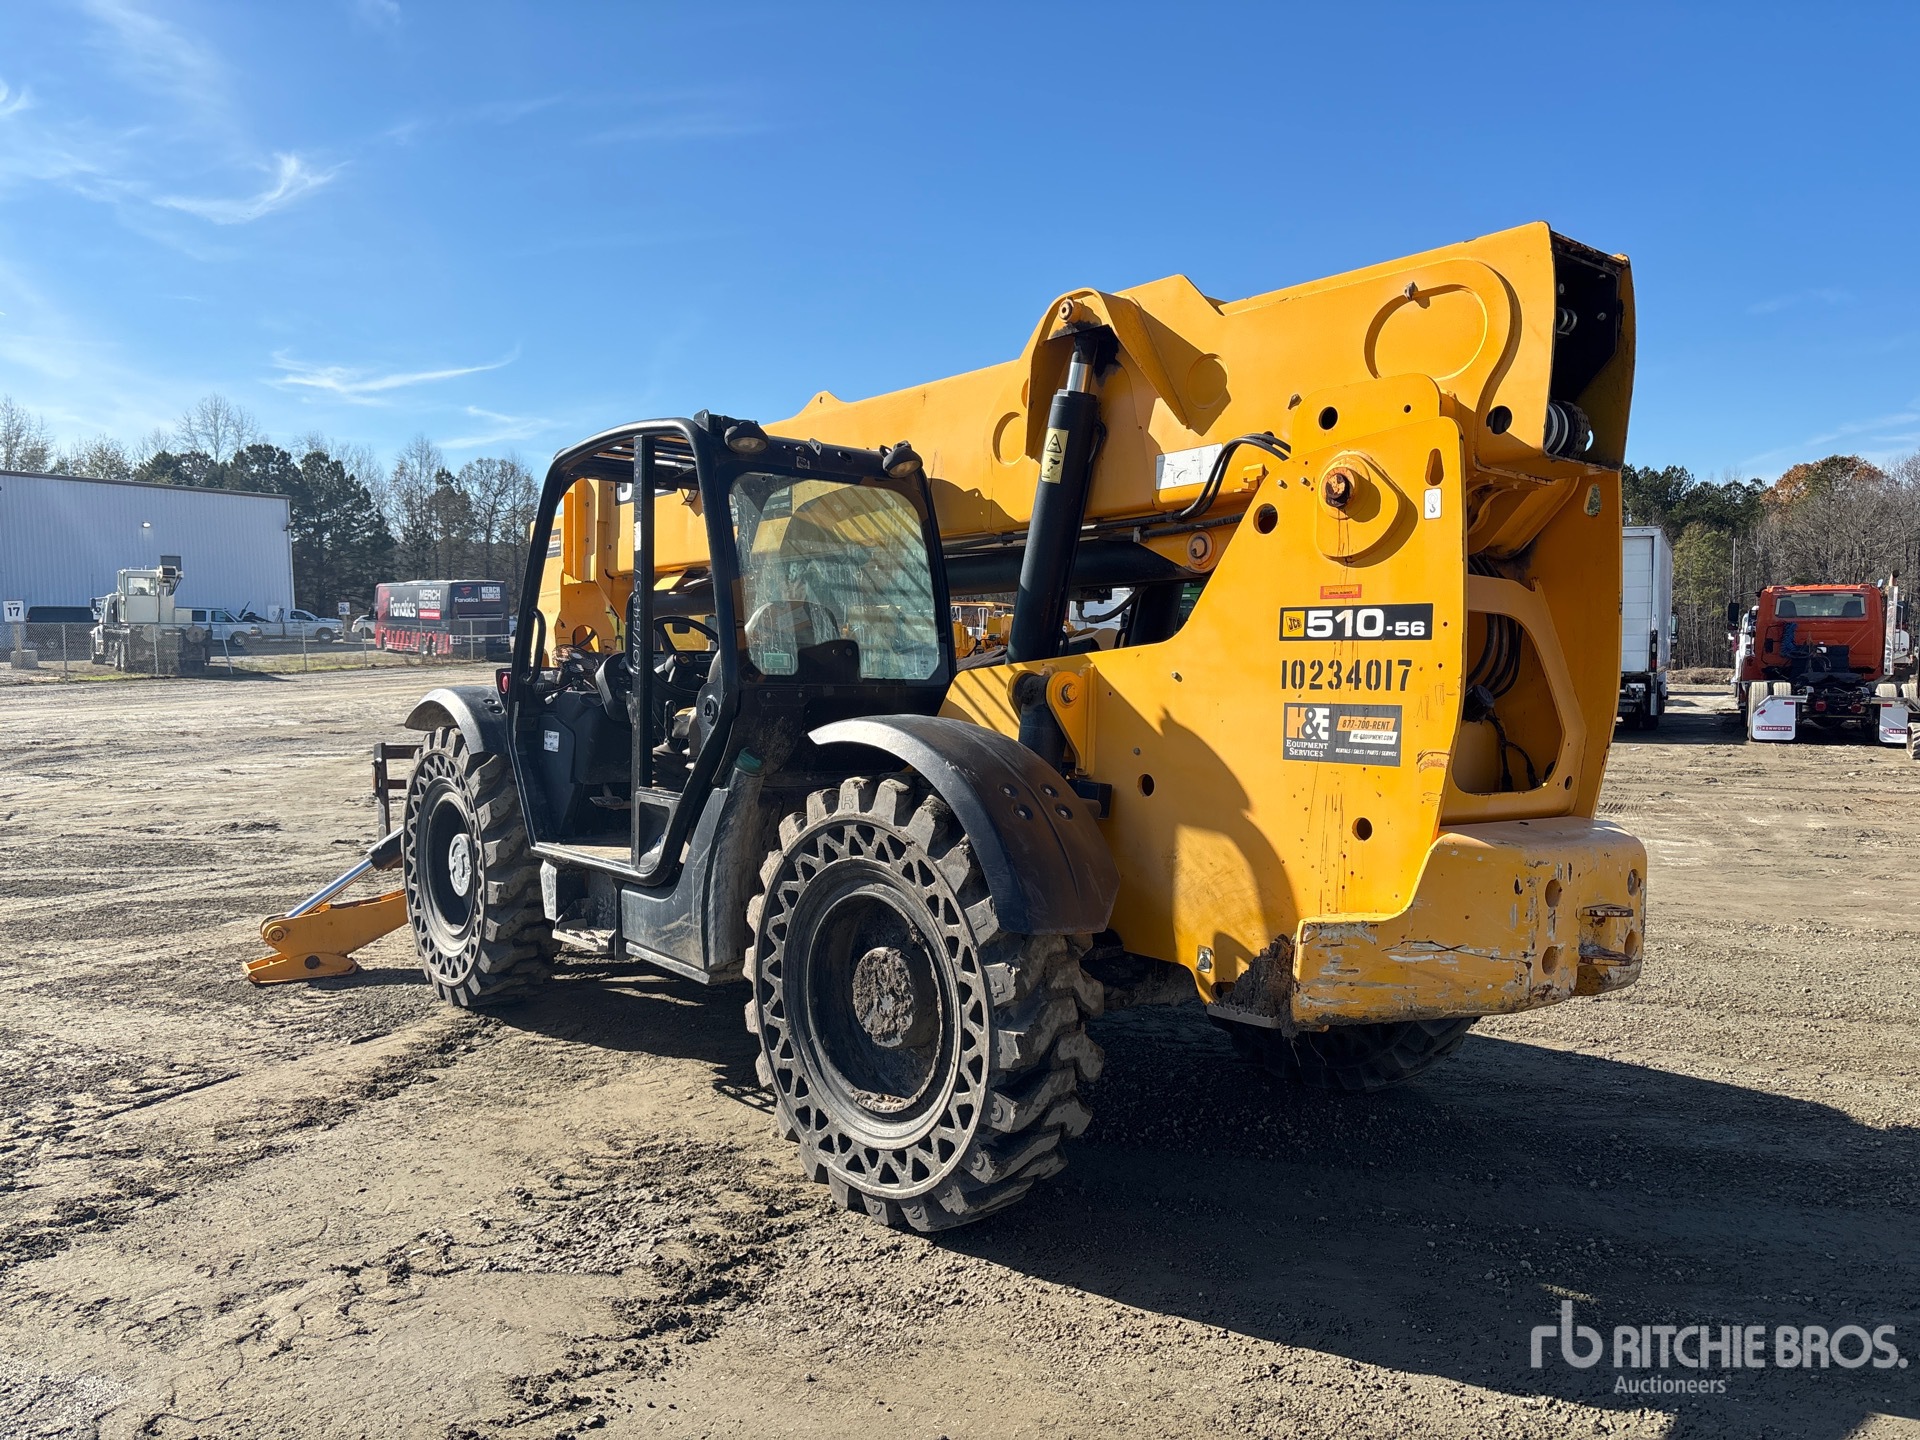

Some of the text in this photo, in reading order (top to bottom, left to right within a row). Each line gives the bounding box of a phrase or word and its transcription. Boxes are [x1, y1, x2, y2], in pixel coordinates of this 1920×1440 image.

[419, 590, 441, 600] MERCH
[481, 586, 500, 594] MERCH
[8, 607, 20, 616] 17
[390, 597, 416, 618] Fanatics
[1287, 616, 1302, 631] JCB
[1307, 608, 1425, 637] 510-56
[1282, 660, 1412, 691] 10234017
[1286, 706, 1330, 740] H&E
[1342, 719, 1390, 730] 877-700-RENT
